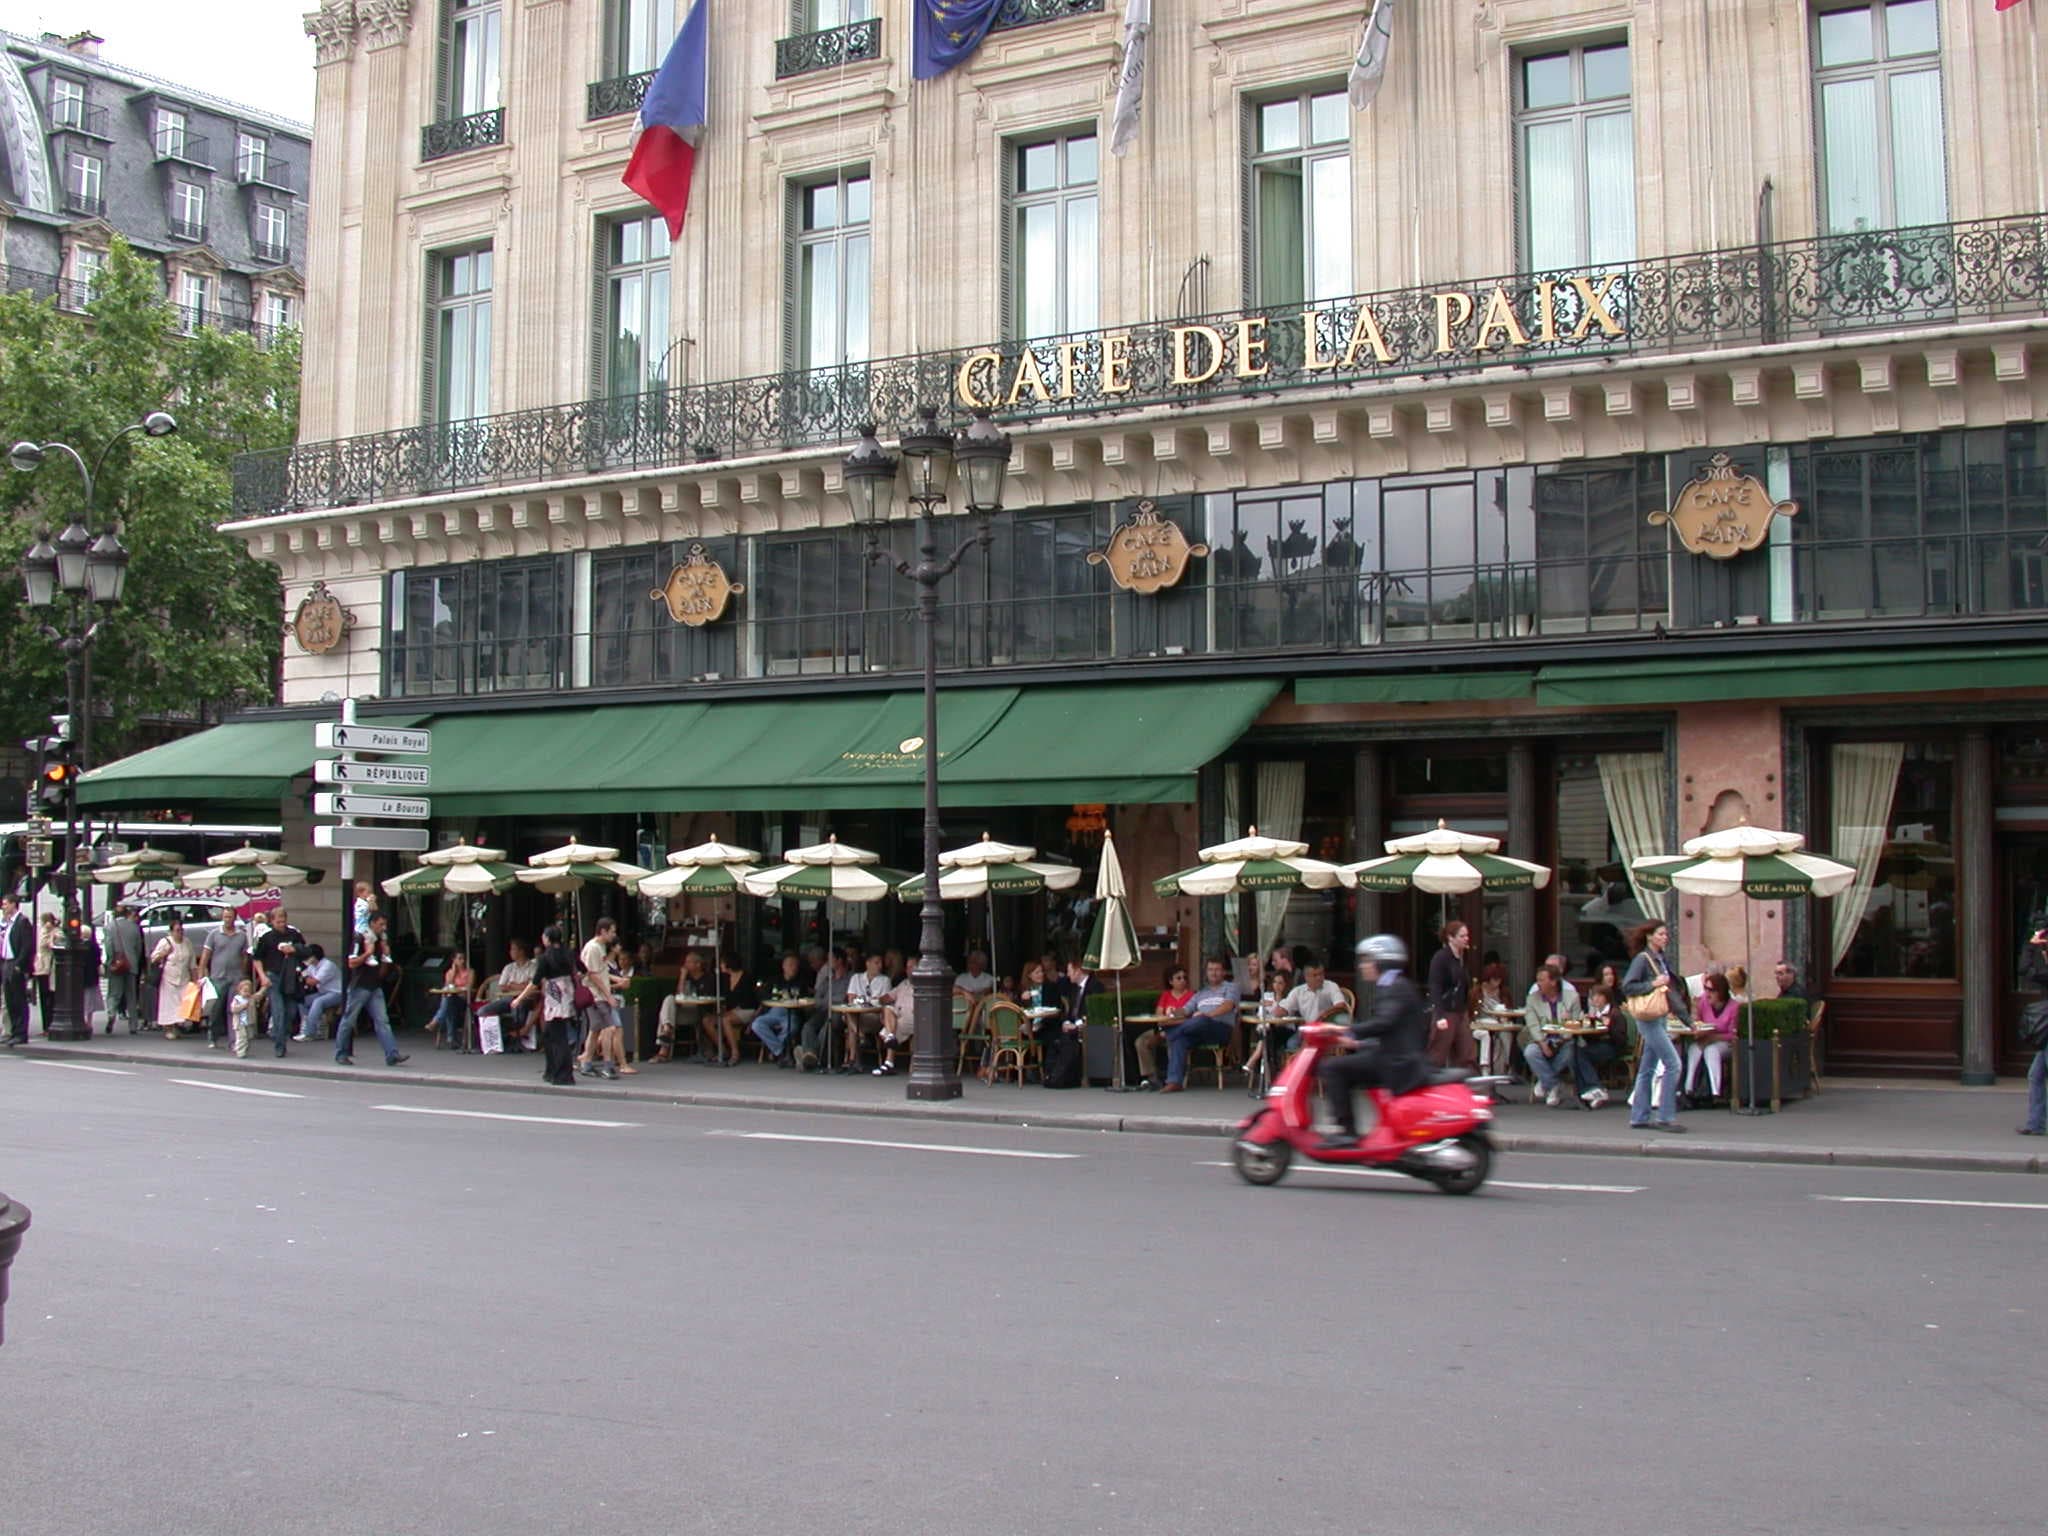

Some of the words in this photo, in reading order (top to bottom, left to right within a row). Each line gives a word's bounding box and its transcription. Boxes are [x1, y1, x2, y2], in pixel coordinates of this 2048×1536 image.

[957, 335, 1132, 408] CAFE
[1169, 317, 1269, 385] DE
[1301, 304, 1393, 370] LA
[1431, 273, 1626, 353] PAIX
[371, 733, 398, 746] Palais
[402, 736, 426, 749] Royal
[365, 767, 426, 781] RÉPUBLIQUE
[381, 801, 392, 812] La
[395, 802, 425, 814] Bourse
